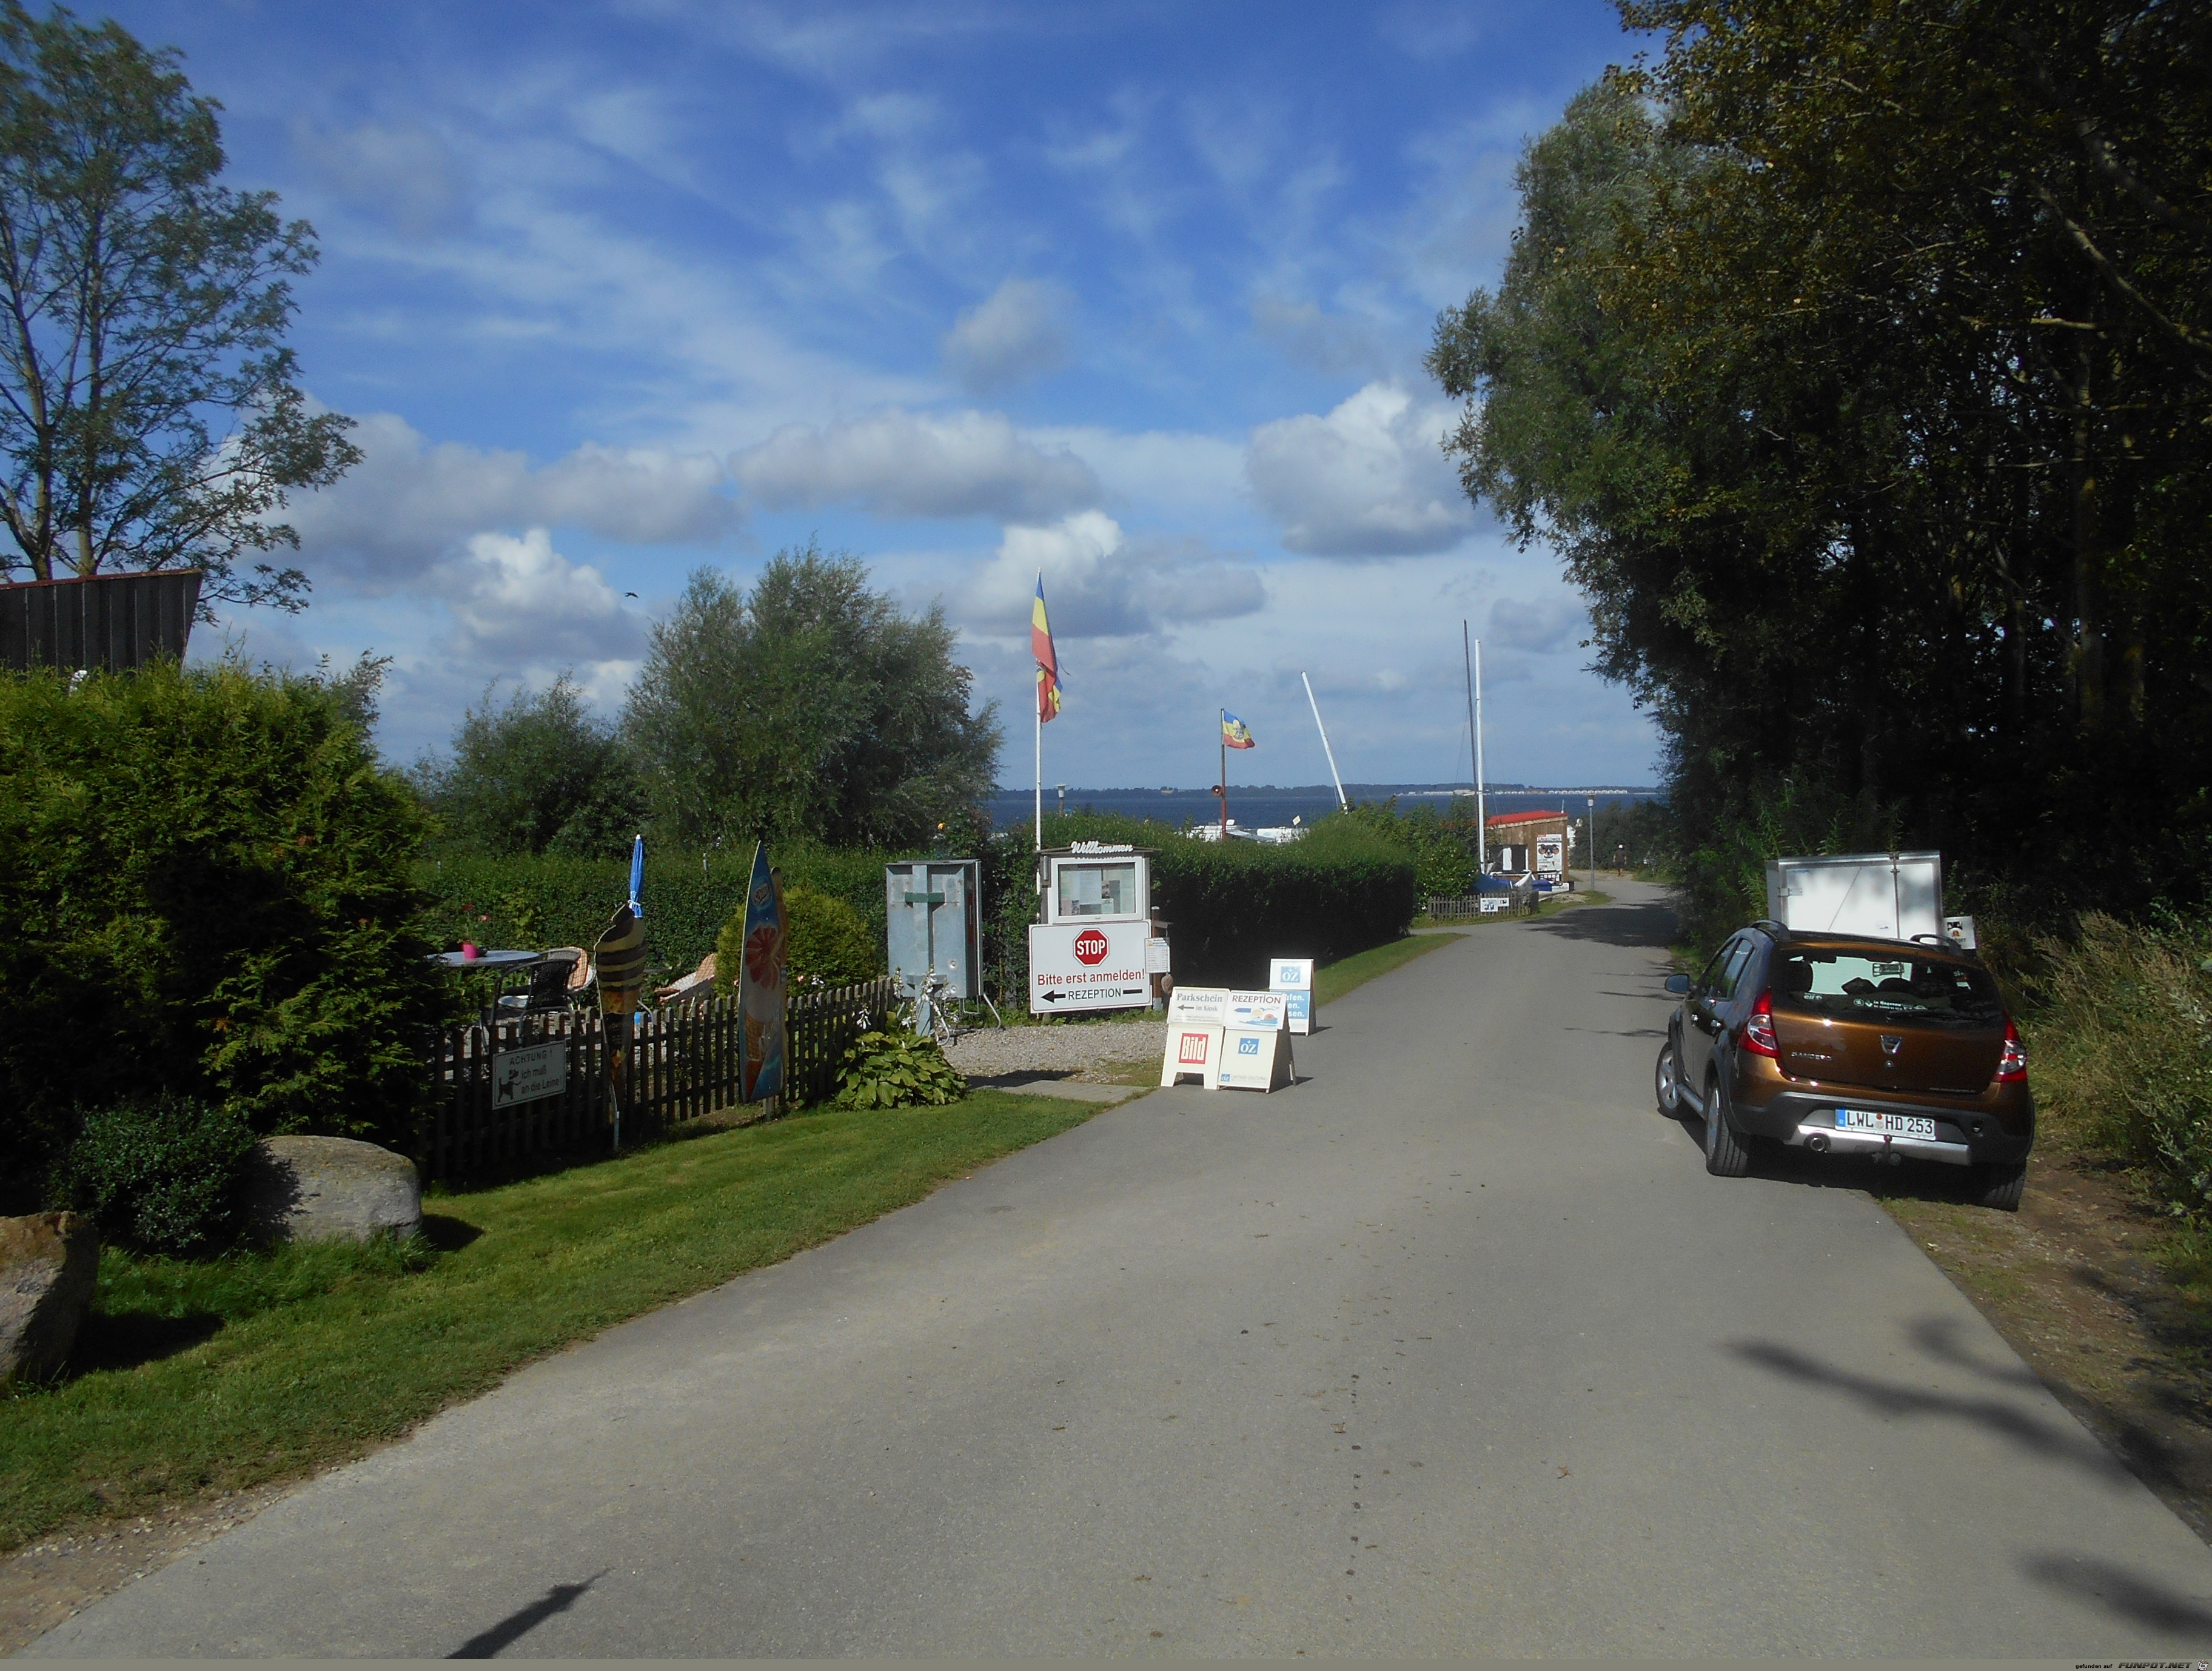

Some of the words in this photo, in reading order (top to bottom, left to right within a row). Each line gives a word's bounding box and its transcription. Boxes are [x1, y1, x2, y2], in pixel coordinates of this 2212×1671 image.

[1071, 840, 1133, 854] Willkommen
[1076, 939, 1105, 956] STOP
[1037, 974, 1062, 985] Bitte
[1066, 972, 1087, 984] erst
[1090, 968, 1145, 982] anmelden!
[1068, 988, 1121, 1000] REZEPTION
[1176, 993, 1222, 1002] Parkschein
[1181, 1036, 1207, 1060] Bild
[510, 1050, 547, 1065] ACHTUNG
[521, 1085, 529, 1094] an
[531, 1082, 541, 1091] die
[1847, 1112, 1874, 1128] LWL
[1885, 1115, 1903, 1131] HD
[1907, 1117, 1932, 1134] 253
